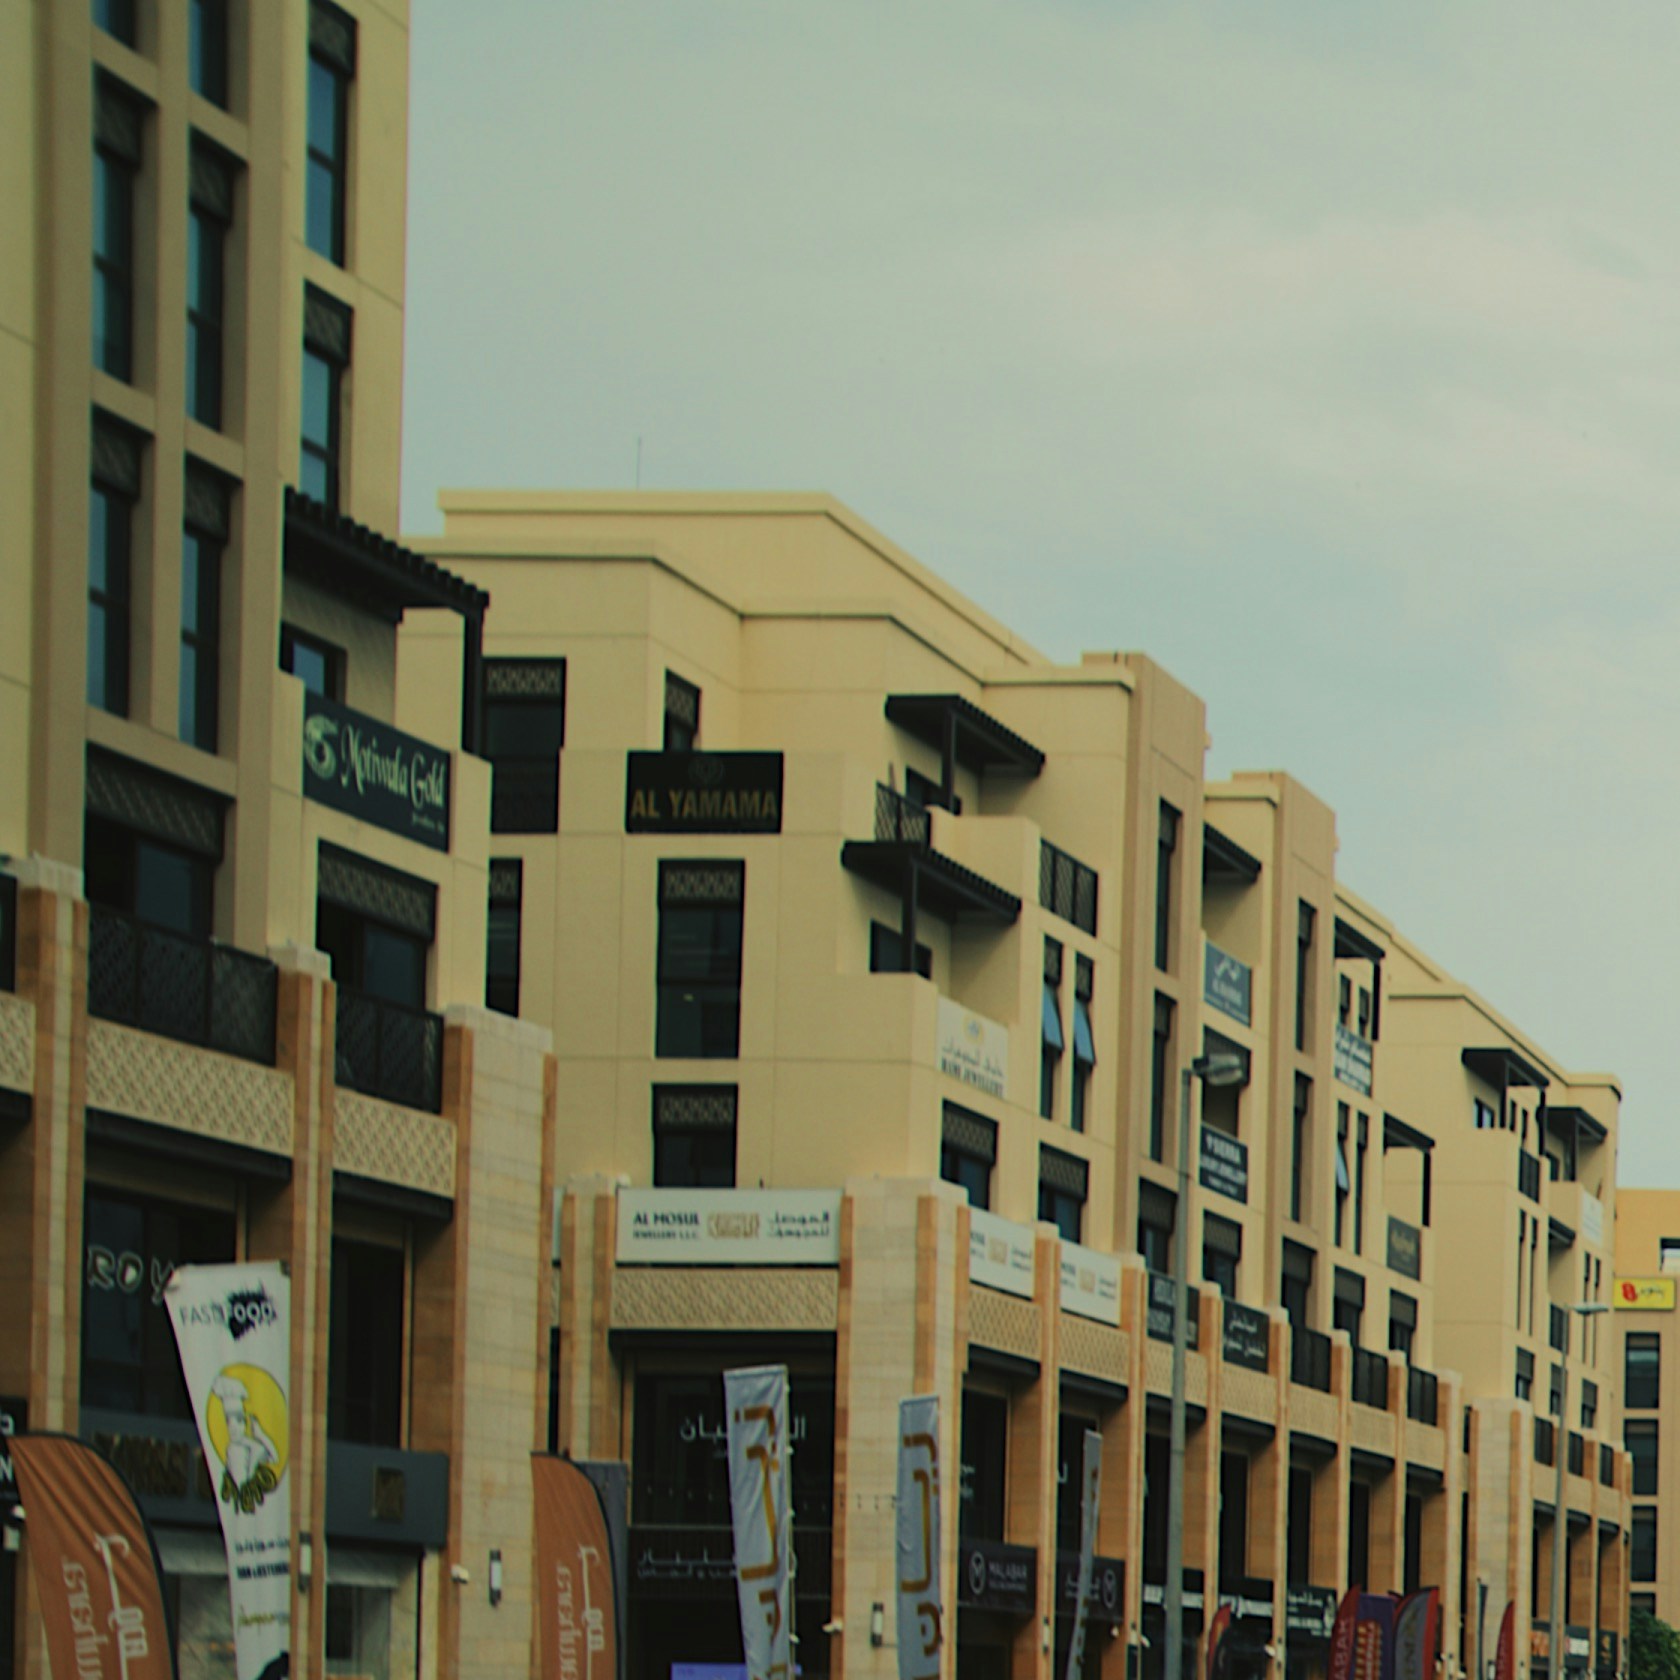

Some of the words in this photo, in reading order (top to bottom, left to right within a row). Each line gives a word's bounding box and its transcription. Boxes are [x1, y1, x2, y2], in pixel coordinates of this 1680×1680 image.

[410, 752, 446, 810] Gold
[631, 788, 660, 818] AL
[668, 788, 779, 818] YAMAMA
